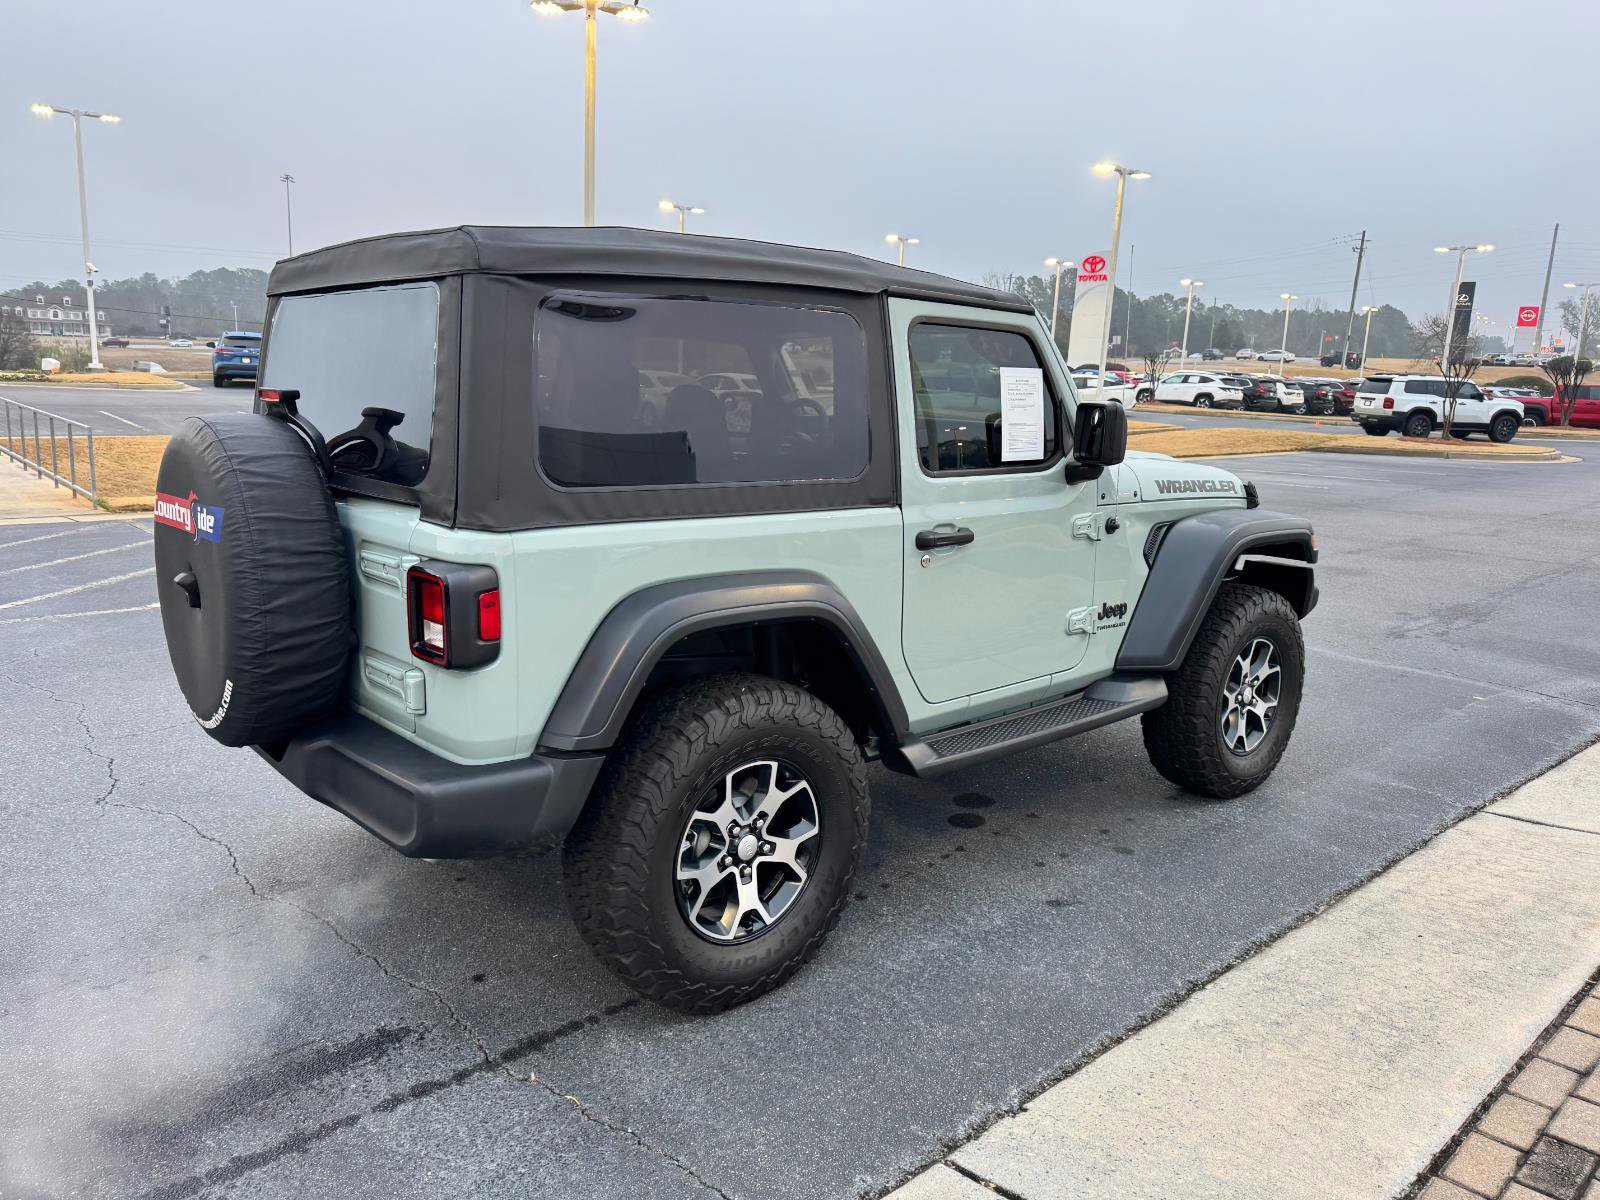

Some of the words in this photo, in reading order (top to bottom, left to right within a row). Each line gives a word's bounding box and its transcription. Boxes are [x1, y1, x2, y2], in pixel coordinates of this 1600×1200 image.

[1078, 274, 1108, 282] TOYOTA
[1154, 479, 1238, 495] WRANGLER
[1097, 602, 1128, 621] Jeep
